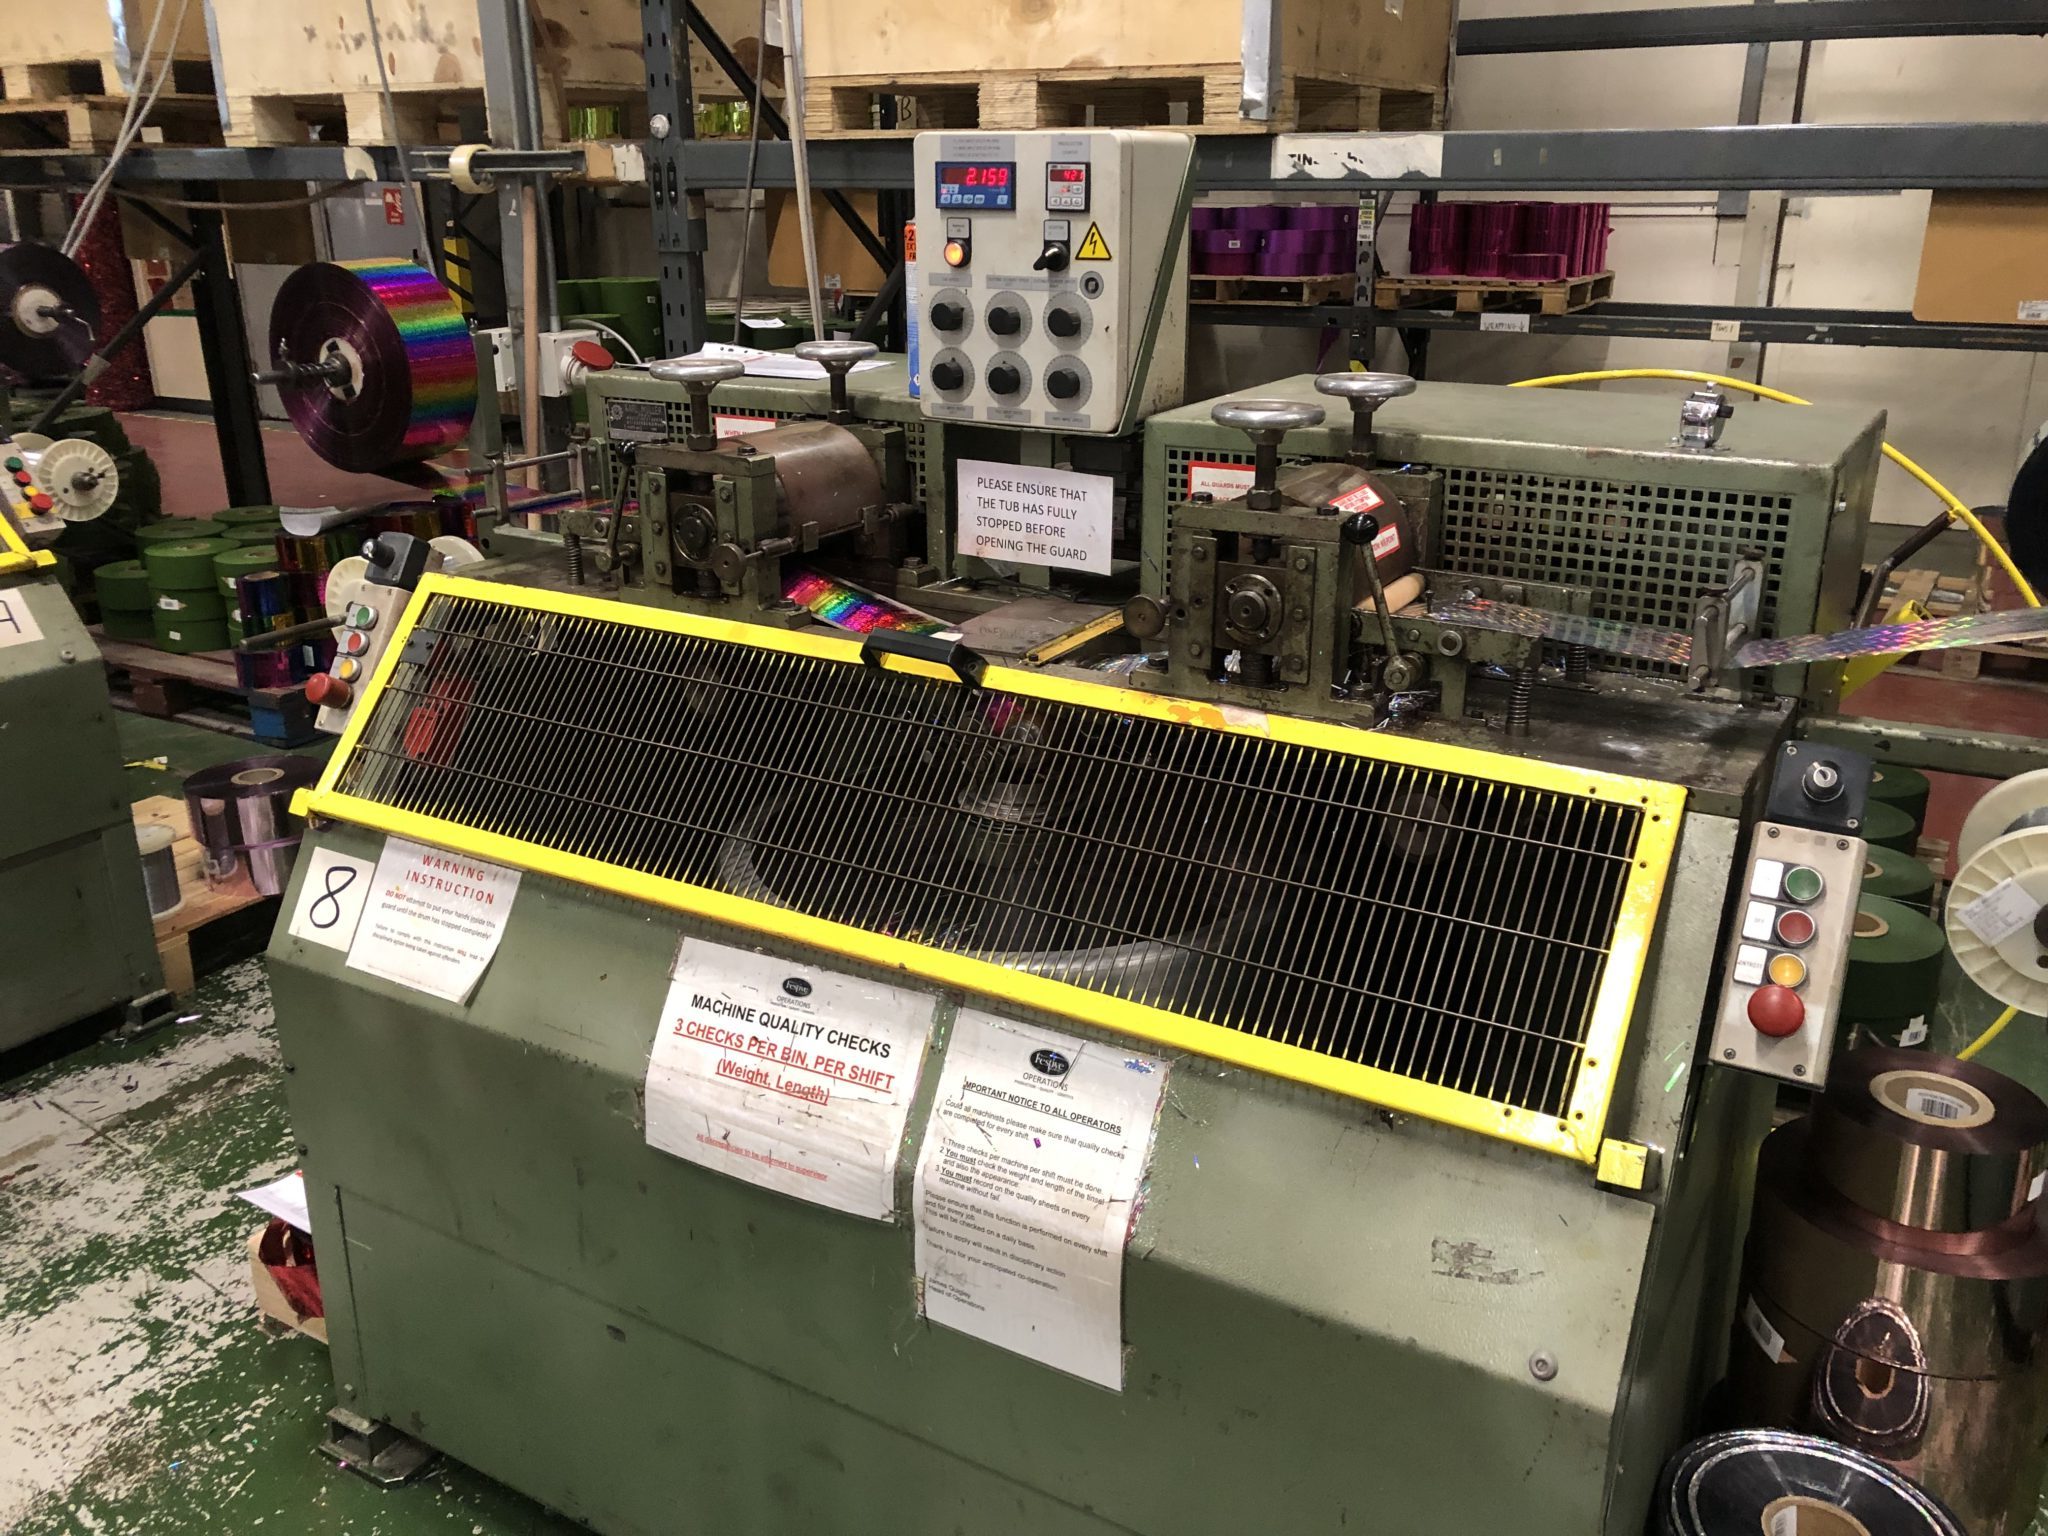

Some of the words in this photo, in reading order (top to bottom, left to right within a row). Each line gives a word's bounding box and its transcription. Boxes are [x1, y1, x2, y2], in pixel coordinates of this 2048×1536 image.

[901, 95, 912, 121] B
[966, 167, 1008, 186] 2.159
[977, 477, 1013, 492] PLEASE
[1016, 482, 1057, 497] ENSURE
[1060, 487, 1087, 502] THAT
[977, 496, 996, 509] THE
[998, 499, 1020, 512] TUB
[1022, 502, 1044, 516] HAS
[1047, 505, 1077, 520] FULLY
[976, 515, 1023, 532] STOPPED
[1025, 522, 1066, 538] BEFORE
[976, 535, 1023, 552] OPENING
[1026, 541, 1047, 555] THE
[1049, 545, 1087, 561] GUARD
[422, 854, 486, 882] WARNING
[309, 866, 357, 929] 8
[406, 870, 495, 905] INSTRUCTION
[381, 902, 397, 912] guard
[397, 905, 408, 914] until
[408, 907, 417, 917] the
[418, 910, 431, 921] drum
[432, 915, 440, 924] has
[441, 918, 461, 931] stopped
[385, 889, 394, 897] DO
[394, 891, 407, 901] NOT
[406, 895, 425, 907] attempt
[426, 900, 432, 909] to
[432, 903, 442, 913] put
[442, 906, 454, 916] your
[454, 909, 470, 920] hands
[470, 915, 486, 925] inside
[486, 918, 496, 928] this
[776, 995, 811, 1009] OPERATIONS
[691, 993, 757, 1023] MACHINE
[758, 1012, 825, 1041] QUALITY
[827, 1029, 892, 1058] CHECKS
[674, 1018, 684, 1032] 3
[686, 1021, 745, 1048] CHECKS
[748, 1035, 778, 1057] PER
[781, 1046, 809, 1068] BIN,
[813, 1055, 845, 1077] PER
[848, 1065, 895, 1090] SHIFT
[716, 1058, 771, 1087] (Weight,
[776, 1074, 831, 1105] Length)
[1023, 1072, 1068, 1091] OPERATIONS
[953, 1112, 985, 1127] completed
[986, 1121, 995, 1129] for
[996, 1126, 1014, 1136] every
[1008, 1094, 1039, 1110] NOTICE
[1040, 1103, 1051, 1113] TO
[1052, 1107, 1067, 1118] ALL
[1070, 1112, 1121, 1134] OPERATORS
[945, 1099, 963, 1110] Could
[972, 1108, 1005, 1123] machinists
[1006, 1118, 1027, 1129] please
[1029, 1125, 1046, 1135] make
[1048, 1131, 1062, 1141] sure
[1064, 1135, 1077, 1145] that
[1078, 1140, 1100, 1152] quality
[1101, 1147, 1125, 1160] checks
[943, 1158, 954, 1167] and
[956, 1162, 969, 1171] also
[970, 1166, 980, 1175] the
[946, 1148, 958, 1158] You
[960, 1154, 976, 1164] must
[977, 1160, 995, 1170] check
[997, 1165, 1007, 1174] the
[1008, 1169, 1030, 1181] weight
[1031, 1176, 1043, 1185] and
[1044, 1180, 1065, 1192] length
[1075, 1190, 1085, 1199] the
[1086, 1194, 1105, 1205] tinsel
[949, 1138, 965, 1150] Three
[966, 1146, 988, 1157] checks
[989, 1153, 1000, 1161] per
[1001, 1157, 1028, 1170] machine
[1029, 1166, 1040, 1174] per
[1042, 1170, 1056, 1179] shift
[1057, 1175, 1073, 1185] must
[1075, 1180, 1083, 1188] be
[939, 1177, 965, 1190] machine
[966, 1186, 988, 1198] without
[941, 1166, 954, 1177] You
[955, 1172, 972, 1183] must
[973, 1178, 993, 1190] record
[994, 1185, 1003, 1193] on
[1004, 1188, 1014, 1196] the
[1015, 1192, 1037, 1205] quality
[1038, 1199, 1060, 1211] sheets
[1061, 1207, 1070, 1215] on
[1071, 1211, 1090, 1222] every
[925, 1189, 946, 1202] Please
[947, 1198, 968, 1209] ensure
[970, 1204, 981, 1214] that
[983, 1209, 994, 1219] this
[995, 1213, 1020, 1227] function
[1029, 1226, 1062, 1242] performed
[1073, 1241, 1092, 1253] every
[925, 1207, 937, 1216] This
[959, 1219, 985, 1232] checked
[1001, 1234, 1016, 1245] daily
[947, 1207, 964, 1217] every
[945, 1247, 956, 1255] you
[968, 1256, 981, 1264] your
[982, 1260, 1016, 1276] anticipated
